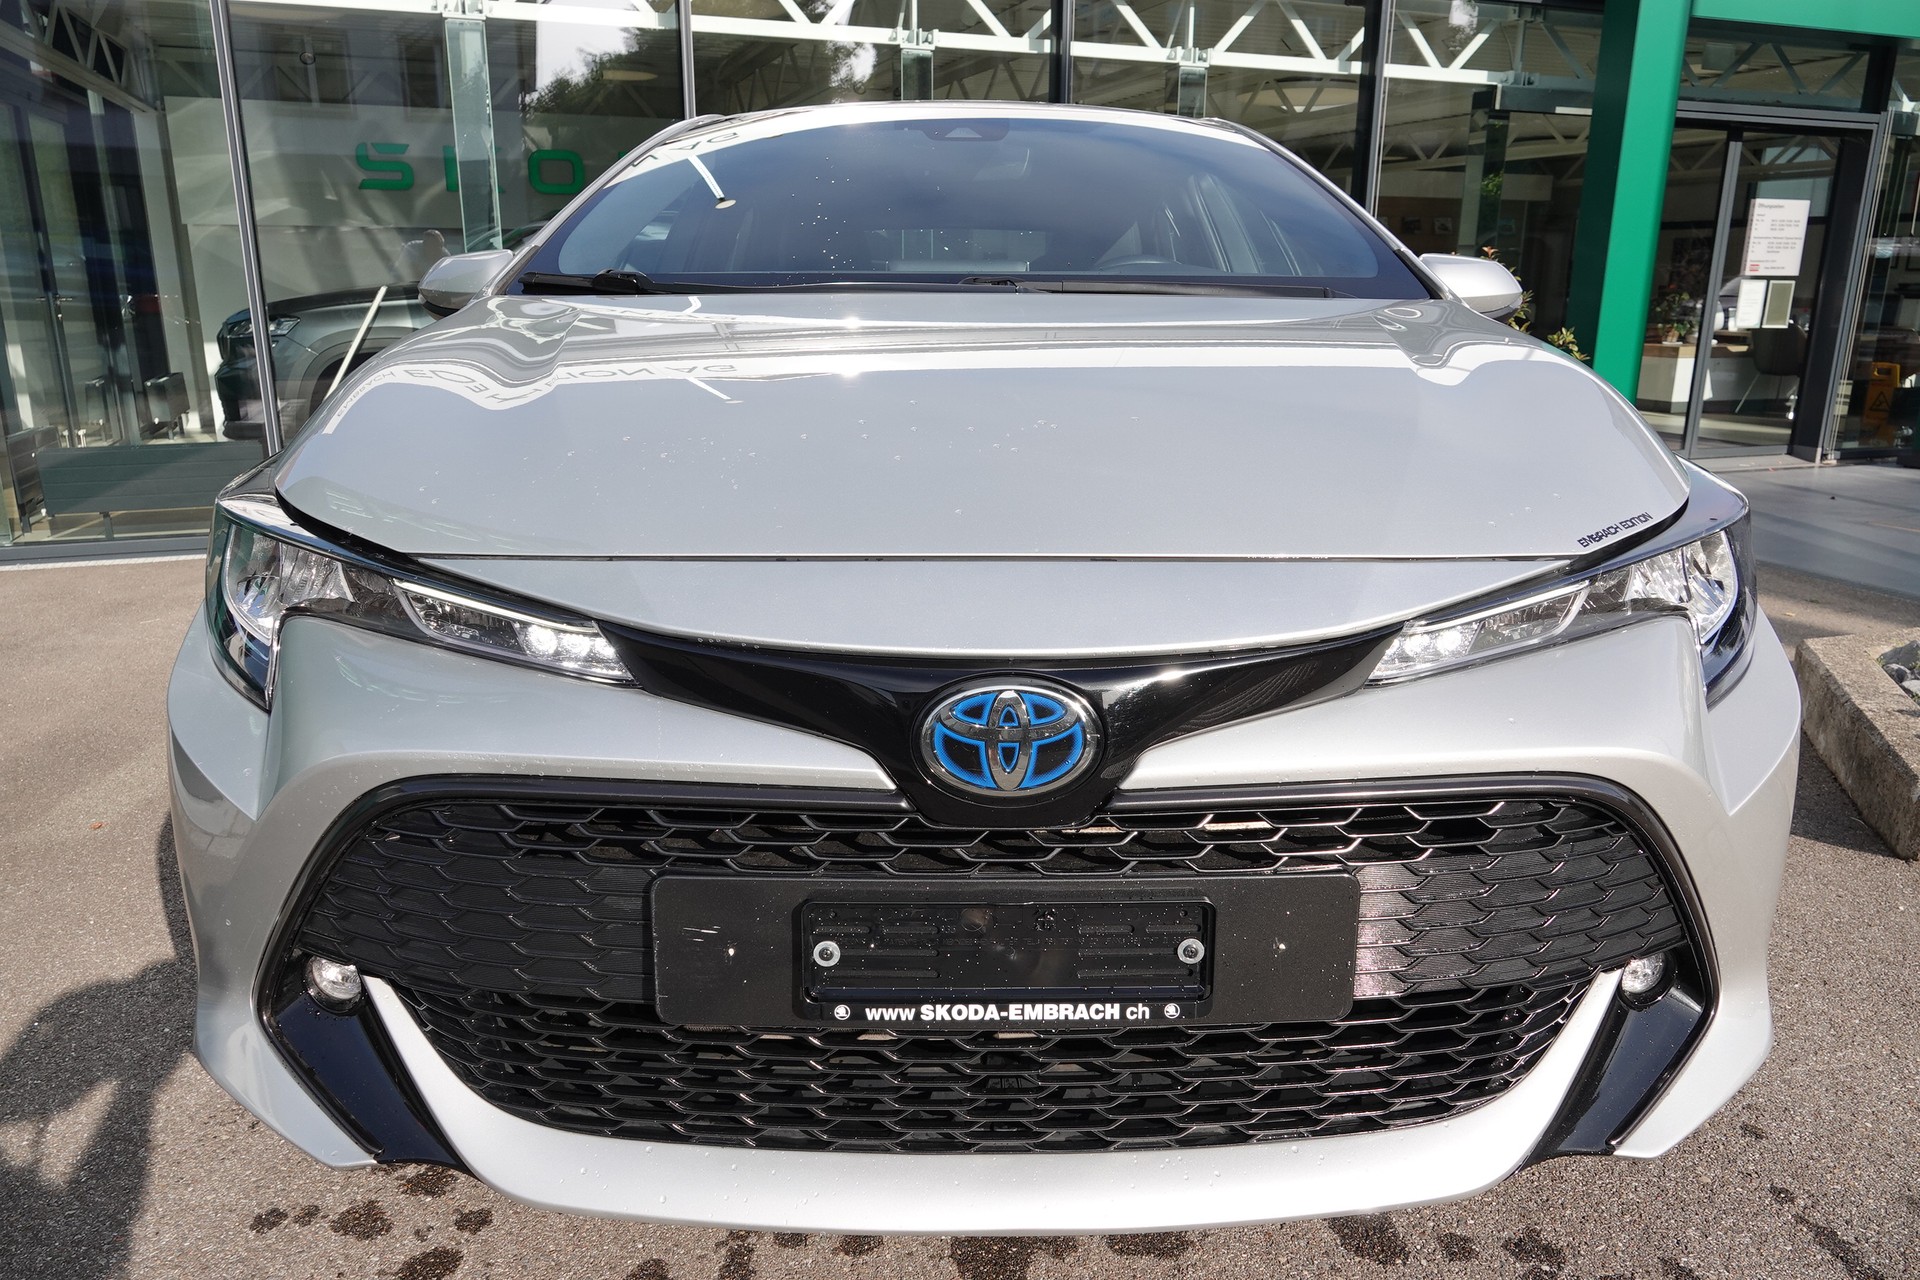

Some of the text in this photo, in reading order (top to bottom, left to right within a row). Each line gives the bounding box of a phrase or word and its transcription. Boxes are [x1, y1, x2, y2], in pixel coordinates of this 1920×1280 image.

[1577, 511, 1653, 548] EMBRACH EDITION
[865, 1003, 1150, 1021] www SKODA-EMBRACH ch
